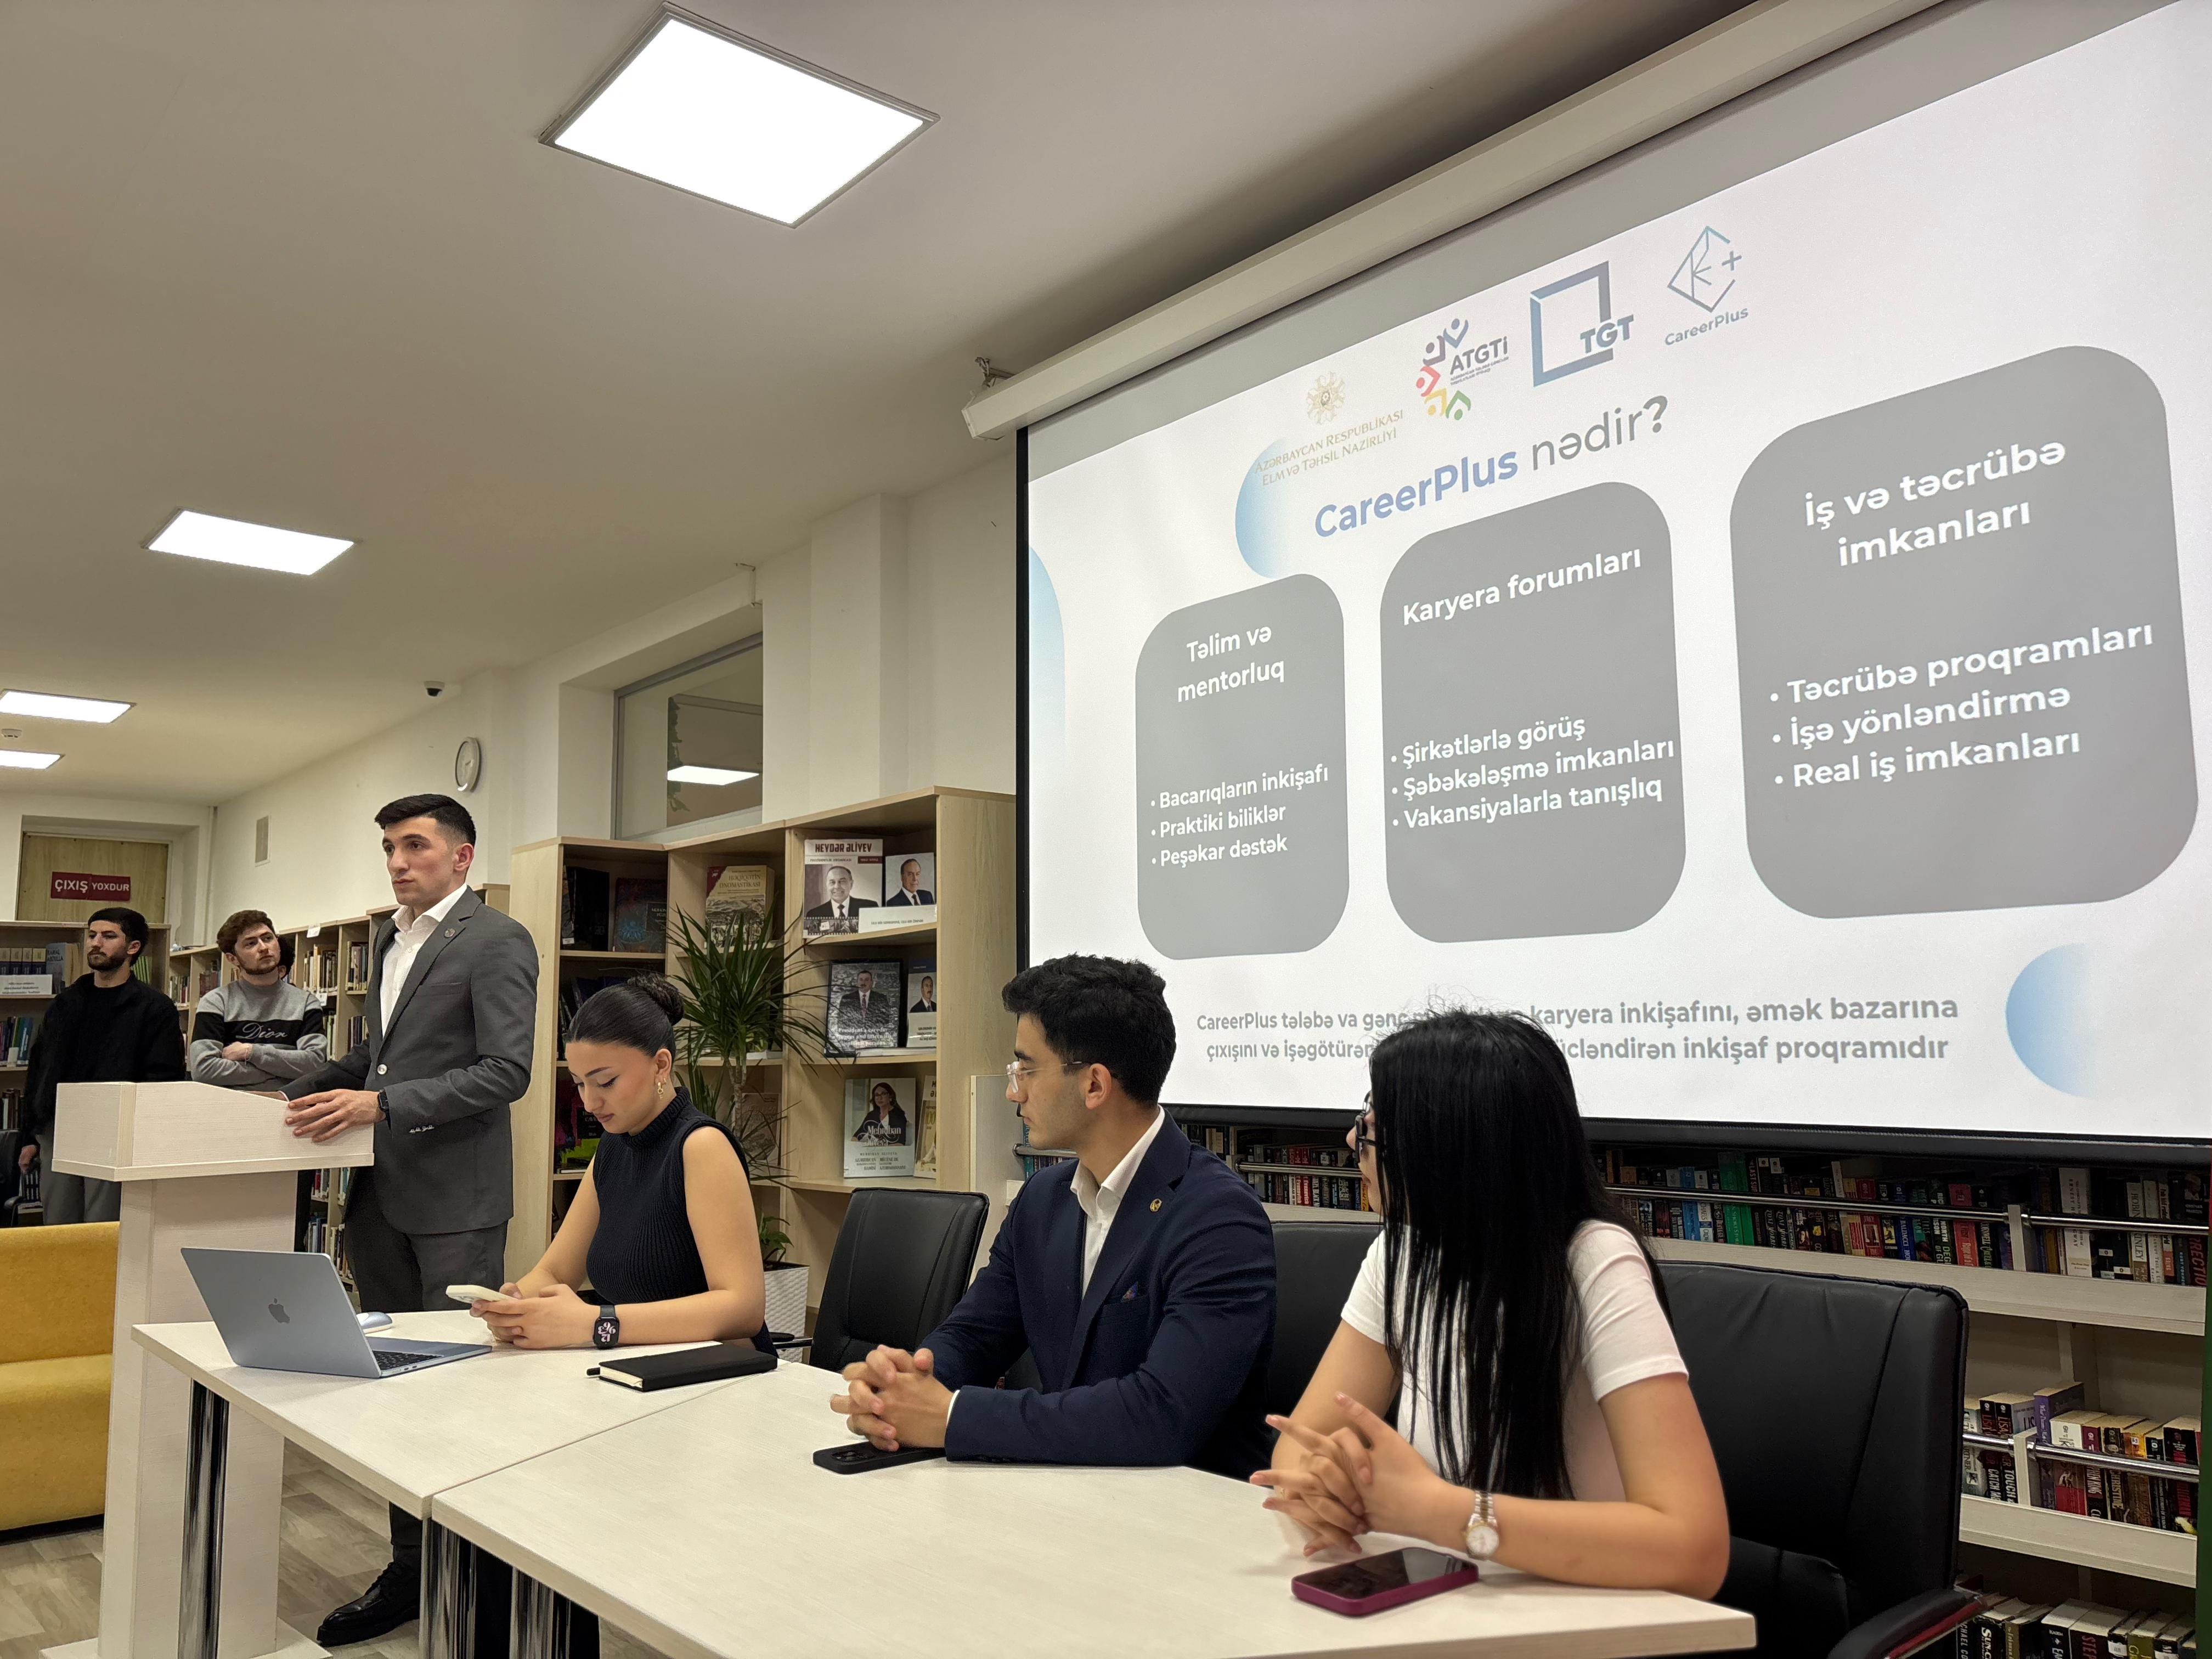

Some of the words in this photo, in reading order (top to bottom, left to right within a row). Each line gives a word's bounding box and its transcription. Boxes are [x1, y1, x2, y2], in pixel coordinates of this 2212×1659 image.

[1580, 314, 1634, 353] TGT
[1664, 307, 1748, 346] CareerPlus
[1262, 471, 1285, 486] ELM
[1286, 465, 1300, 477] VƏ
[1314, 447, 1518, 538] CareerPlus
[1532, 395, 1668, 471] nədir?
[1805, 492, 1835, 529] İş
[1844, 488, 1889, 515] və
[1900, 442, 2066, 501] təcrübə
[1838, 501, 2030, 566] imkanları
[1403, 586, 1500, 625] Karyera
[1507, 549, 1641, 599] forumları
[1187, 633, 1240, 662] Təlim
[1246, 626, 1272, 646] və
[1178, 661, 1284, 702] mentorluq
[1787, 664, 1917, 703] Təcrübə
[1927, 625, 2153, 687] proqramları
[1791, 716, 1833, 749] İşə
[1843, 687, 2070, 743] yönləndirmə
[1403, 729, 1511, 769] Şirkətlərlə
[1517, 716, 1585, 750] görüş
[1793, 755, 1860, 787] Real
[1870, 752, 1896, 782] iş
[1905, 732, 2080, 773] imkanları
[1160, 780, 1257, 808] Bacarıqların
[1262, 763, 1328, 791] inkişafı
[1403, 762, 1548, 802] Şəbəkələşmə
[1555, 740, 1674, 774] imkanları
[1404, 789, 1562, 828] Vakansiyalarla
[1569, 777, 1662, 807] tanışlıq
[1160, 811, 1222, 837] Praktiki
[1228, 805, 1286, 829] biliklər
[1161, 844, 1224, 868] Peşəkar
[1229, 833, 1288, 858] dəstək
[54, 879, 88, 894] ÇIXIŞ
[92, 882, 129, 892] YOXDUR
[1197, 1012, 1277, 1030] CareerPlus
[1282, 1011, 1334, 1029] tələbə
[1338, 1013, 1357, 1028] va
[1531, 1005, 1613, 1029] karyera
[1620, 1000, 1739, 1029] inkişafını,
[1746, 997, 1822, 1022] əmək
[1831, 997, 1958, 1019] bazarına
[236, 1023, 289, 1040] Dior
[1207, 1042, 1257, 1063] çıxışını
[1261, 1044, 1279, 1058] və
[1683, 1036, 1768, 1065] inkişaf
[1776, 1035, 1949, 1064] proqramıdır
[2132, 1193, 2141, 1217] ROBIN
[1766, 1225, 1777, 1249] MORRI
[1778, 1226, 1788, 1249] MORRI
[1900, 1220, 1910, 1246] BALDACCI
[1940, 1221, 1949, 1243] NORTH
[2135, 1234, 2144, 1260] INLEY
[1943, 1246, 1952, 1264] DEG
[1997, 1416, 2009, 1432] LISA
[2005, 1470, 2016, 1498] TOUCH
[1988, 1469, 2000, 1491] CATCH
[2088, 1481, 2103, 1494] KING
[2109, 1470, 2124, 1509] CHRISTINE
[1960, 1624, 1968, 1646] CHAEL
